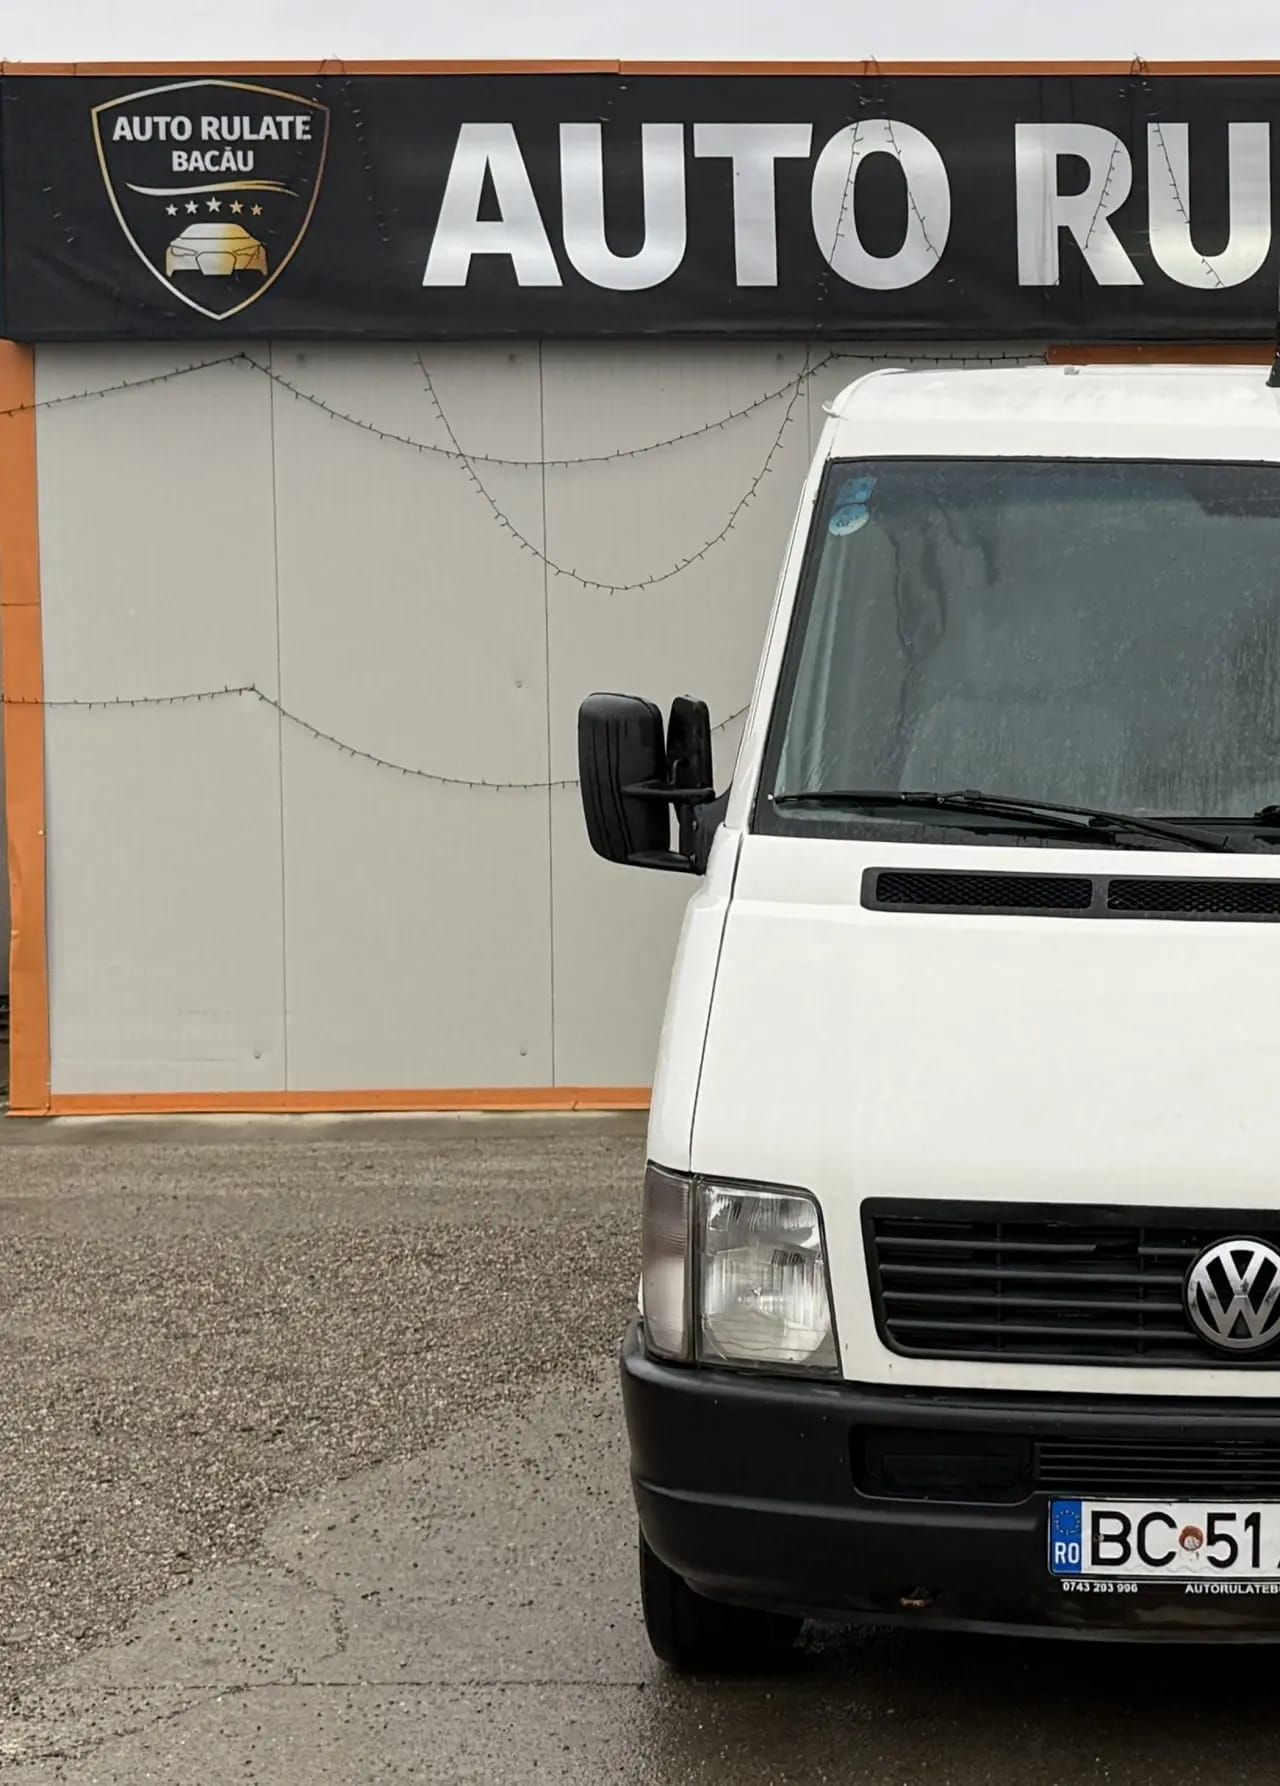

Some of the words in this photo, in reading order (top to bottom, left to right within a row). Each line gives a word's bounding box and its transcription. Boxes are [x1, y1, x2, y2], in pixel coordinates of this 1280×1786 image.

[112, 115, 193, 142] AUTO
[201, 115, 312, 141] RULATE
[172, 146, 254, 172] BACĂU
[422, 118, 952, 291] AUTO
[1090, 1510, 1178, 1568] BC
[1205, 1510, 1261, 1569] 51
[1055, 1541, 1080, 1565] RO
[1062, 1581, 1090, 1592] 0743
